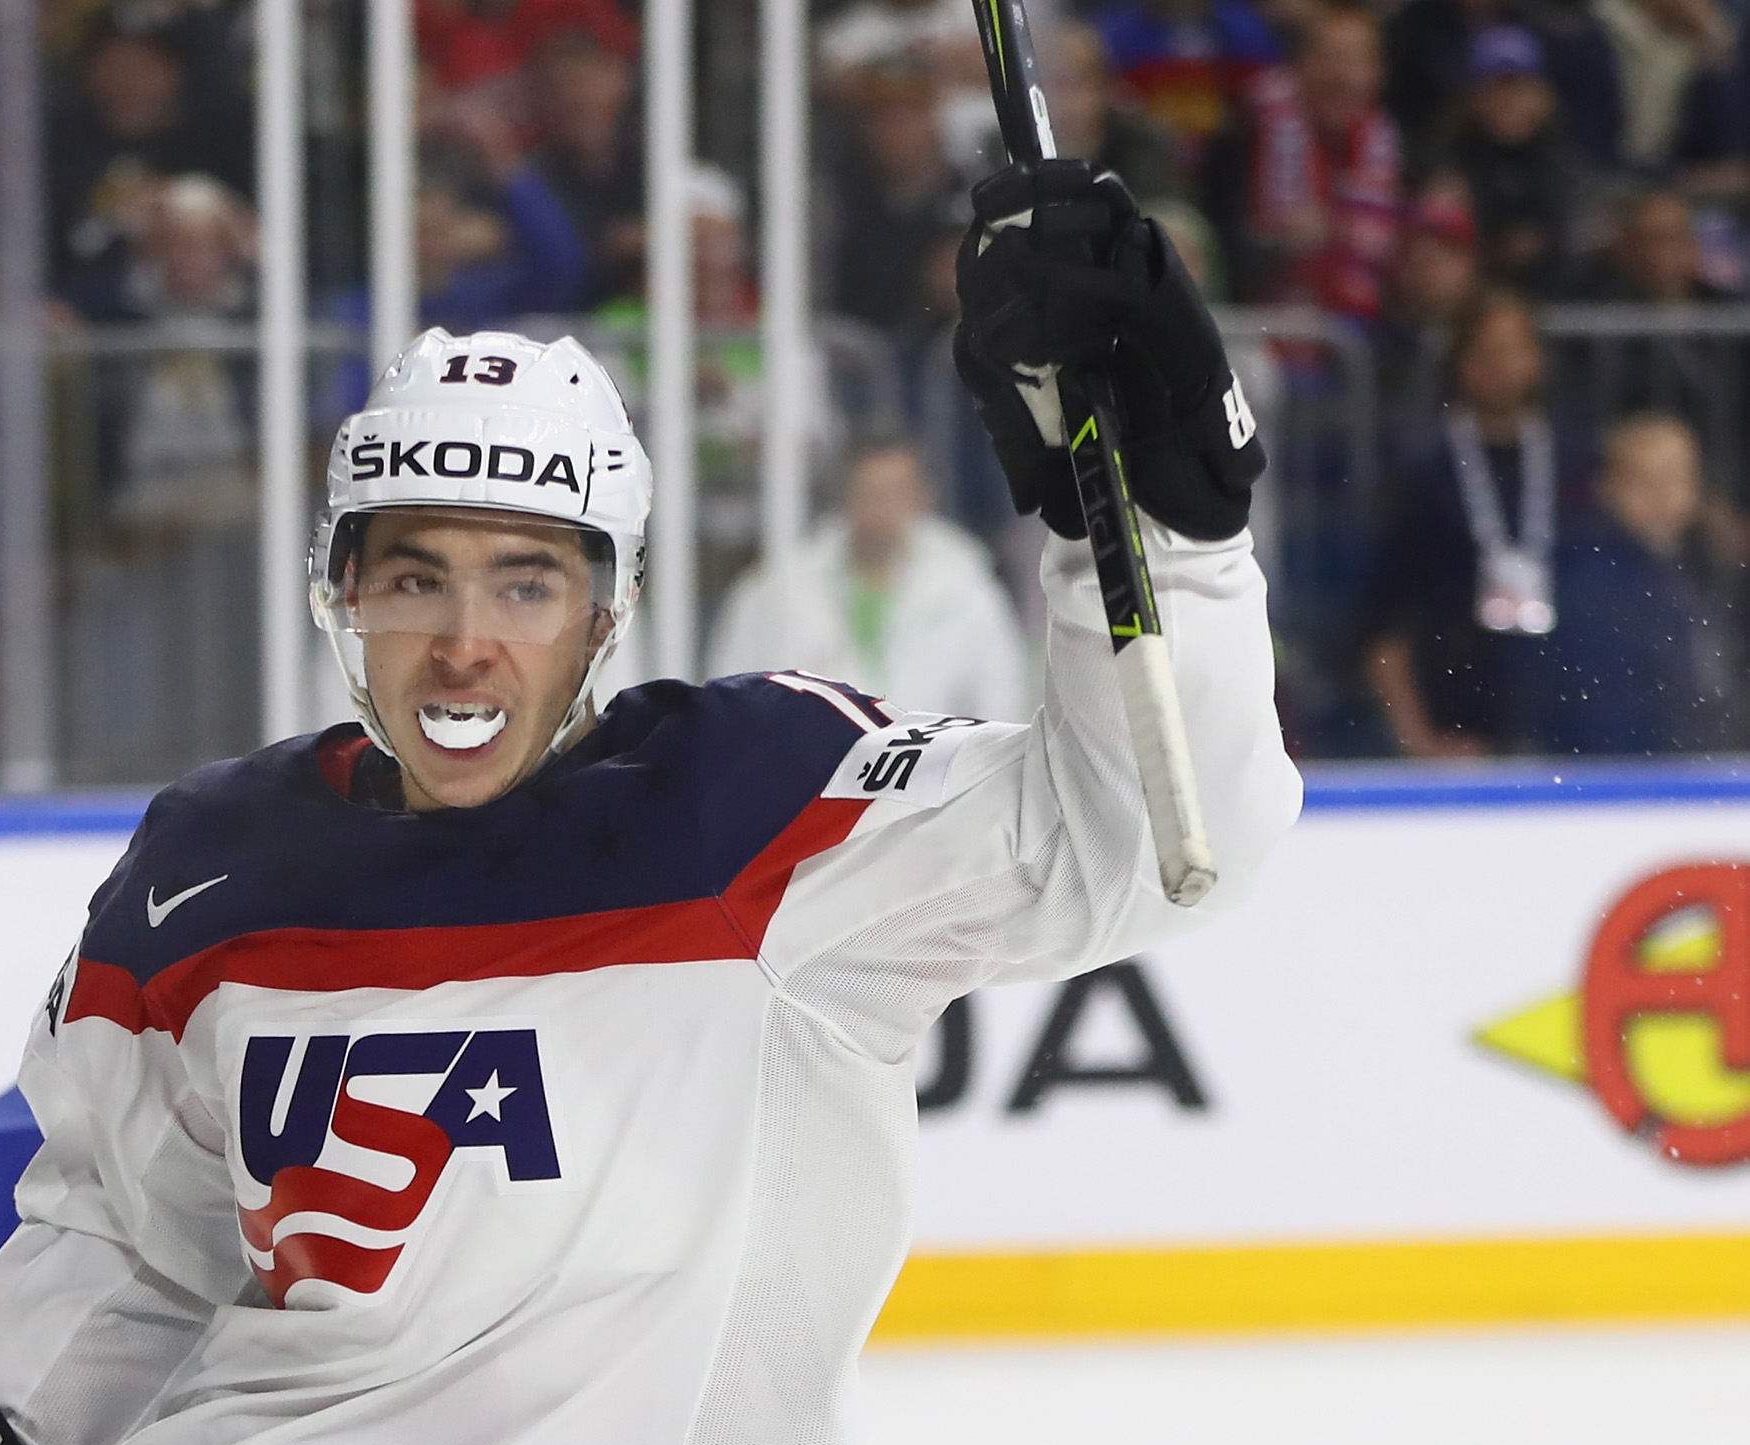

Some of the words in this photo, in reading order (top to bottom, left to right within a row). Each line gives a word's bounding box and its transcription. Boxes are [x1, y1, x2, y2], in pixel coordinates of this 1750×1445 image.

[439, 354, 518, 387] 13
[350, 434, 581, 494] ŠKODA
[238, 1028, 563, 1310] USA
